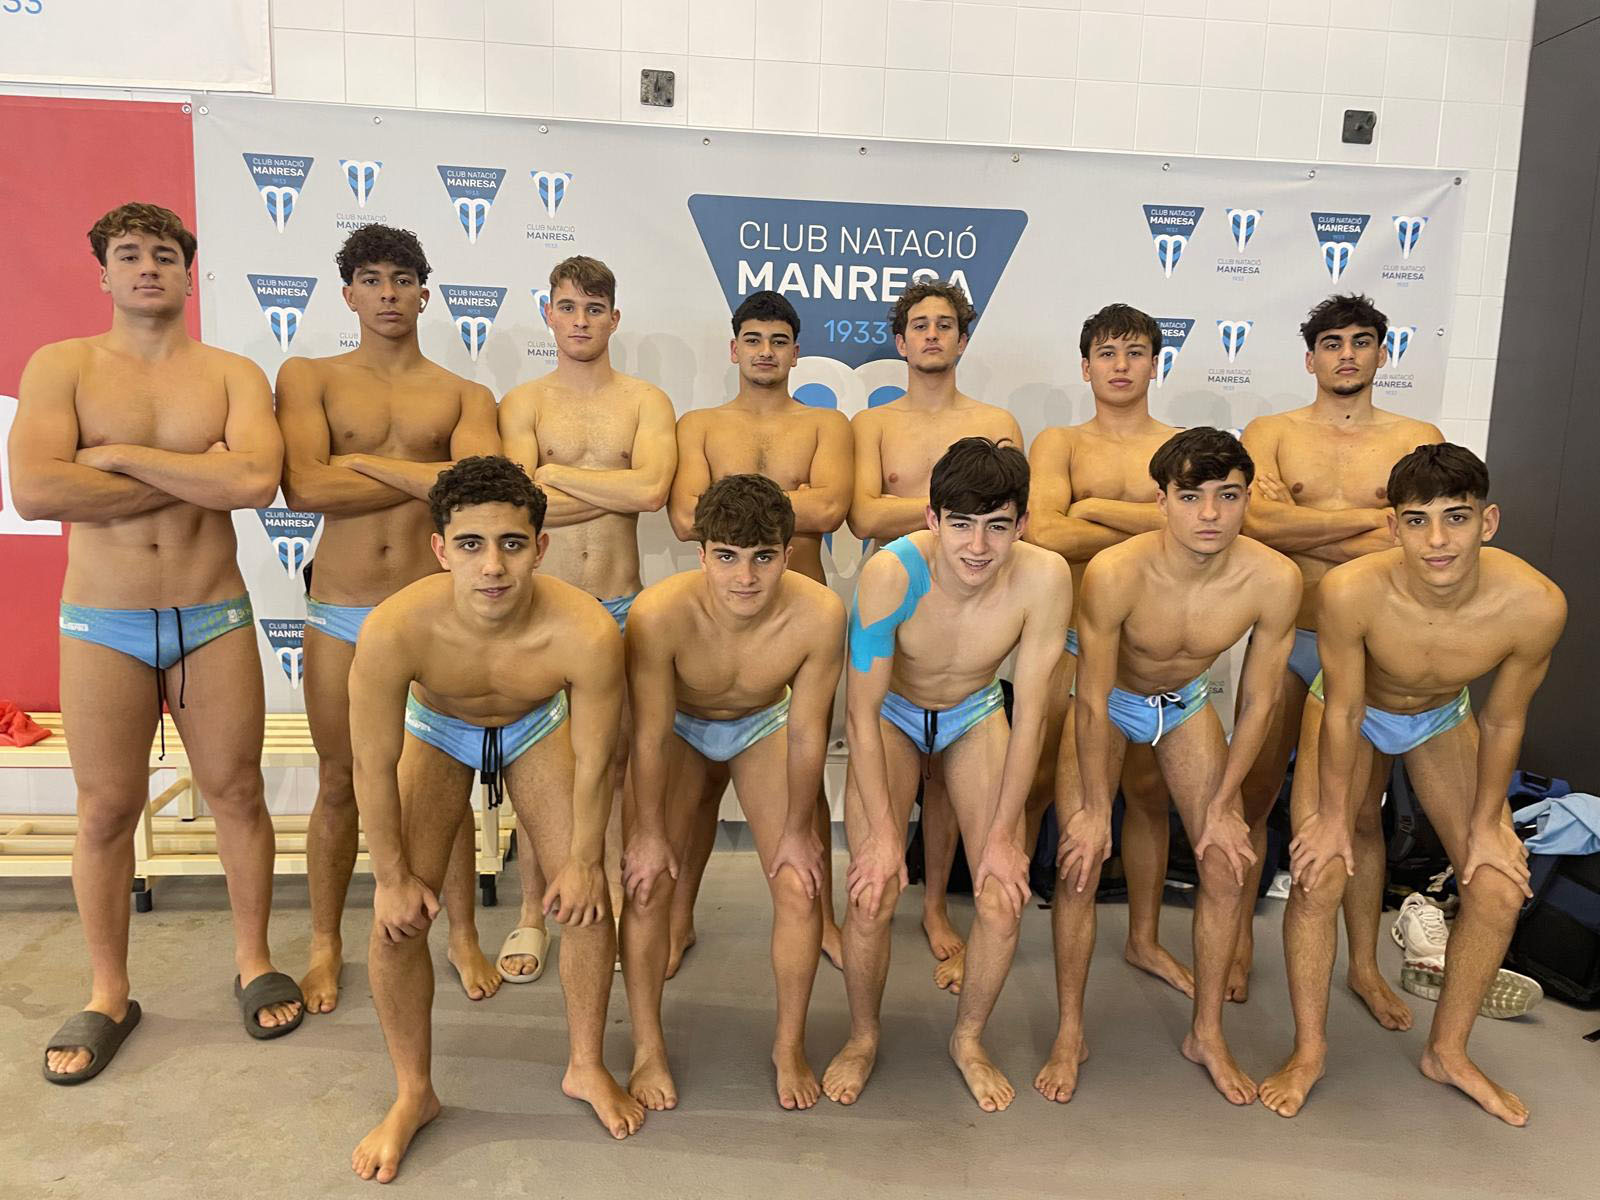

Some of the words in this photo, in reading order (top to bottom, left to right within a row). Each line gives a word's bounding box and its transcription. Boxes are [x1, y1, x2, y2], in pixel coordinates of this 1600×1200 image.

[252, 157, 273, 166] CLUB
[274, 159, 305, 168] NATACIÓ
[253, 166, 304, 177] MANRESA
[447, 170, 466, 178] CLUB
[467, 171, 497, 179] NATACIÓ
[447, 178, 496, 189] MANRESA
[336, 213, 356, 221] CLUB
[1169, 209, 1196, 218] NATACIÓ
[1150, 217, 1195, 226] MANRESA
[1318, 216, 1335, 224] CLUB
[526, 223, 545, 231] CLUB
[1317, 224, 1361, 233] MANRESA
[526, 231, 575, 242] MANRESA
[739, 221, 828, 253] CLUB
[840, 225, 977, 260] NATACIÓ
[1216, 266, 1260, 274] MANRESA
[1382, 272, 1424, 280] MANRESA
[278, 280, 308, 288] NATACIÓ
[257, 287, 308, 297] MANRESA
[469, 290, 498, 298] NATACIÓ
[449, 297, 498, 307] MANRESA
[824, 319, 888, 344] 1933
[1161, 329, 1185, 337] RESA
[527, 349, 557, 357] MANR
[1208, 375, 1250, 384] MANRESA
[265, 519, 315, 528] MANRESA
[269, 630, 304, 638] MANRE
